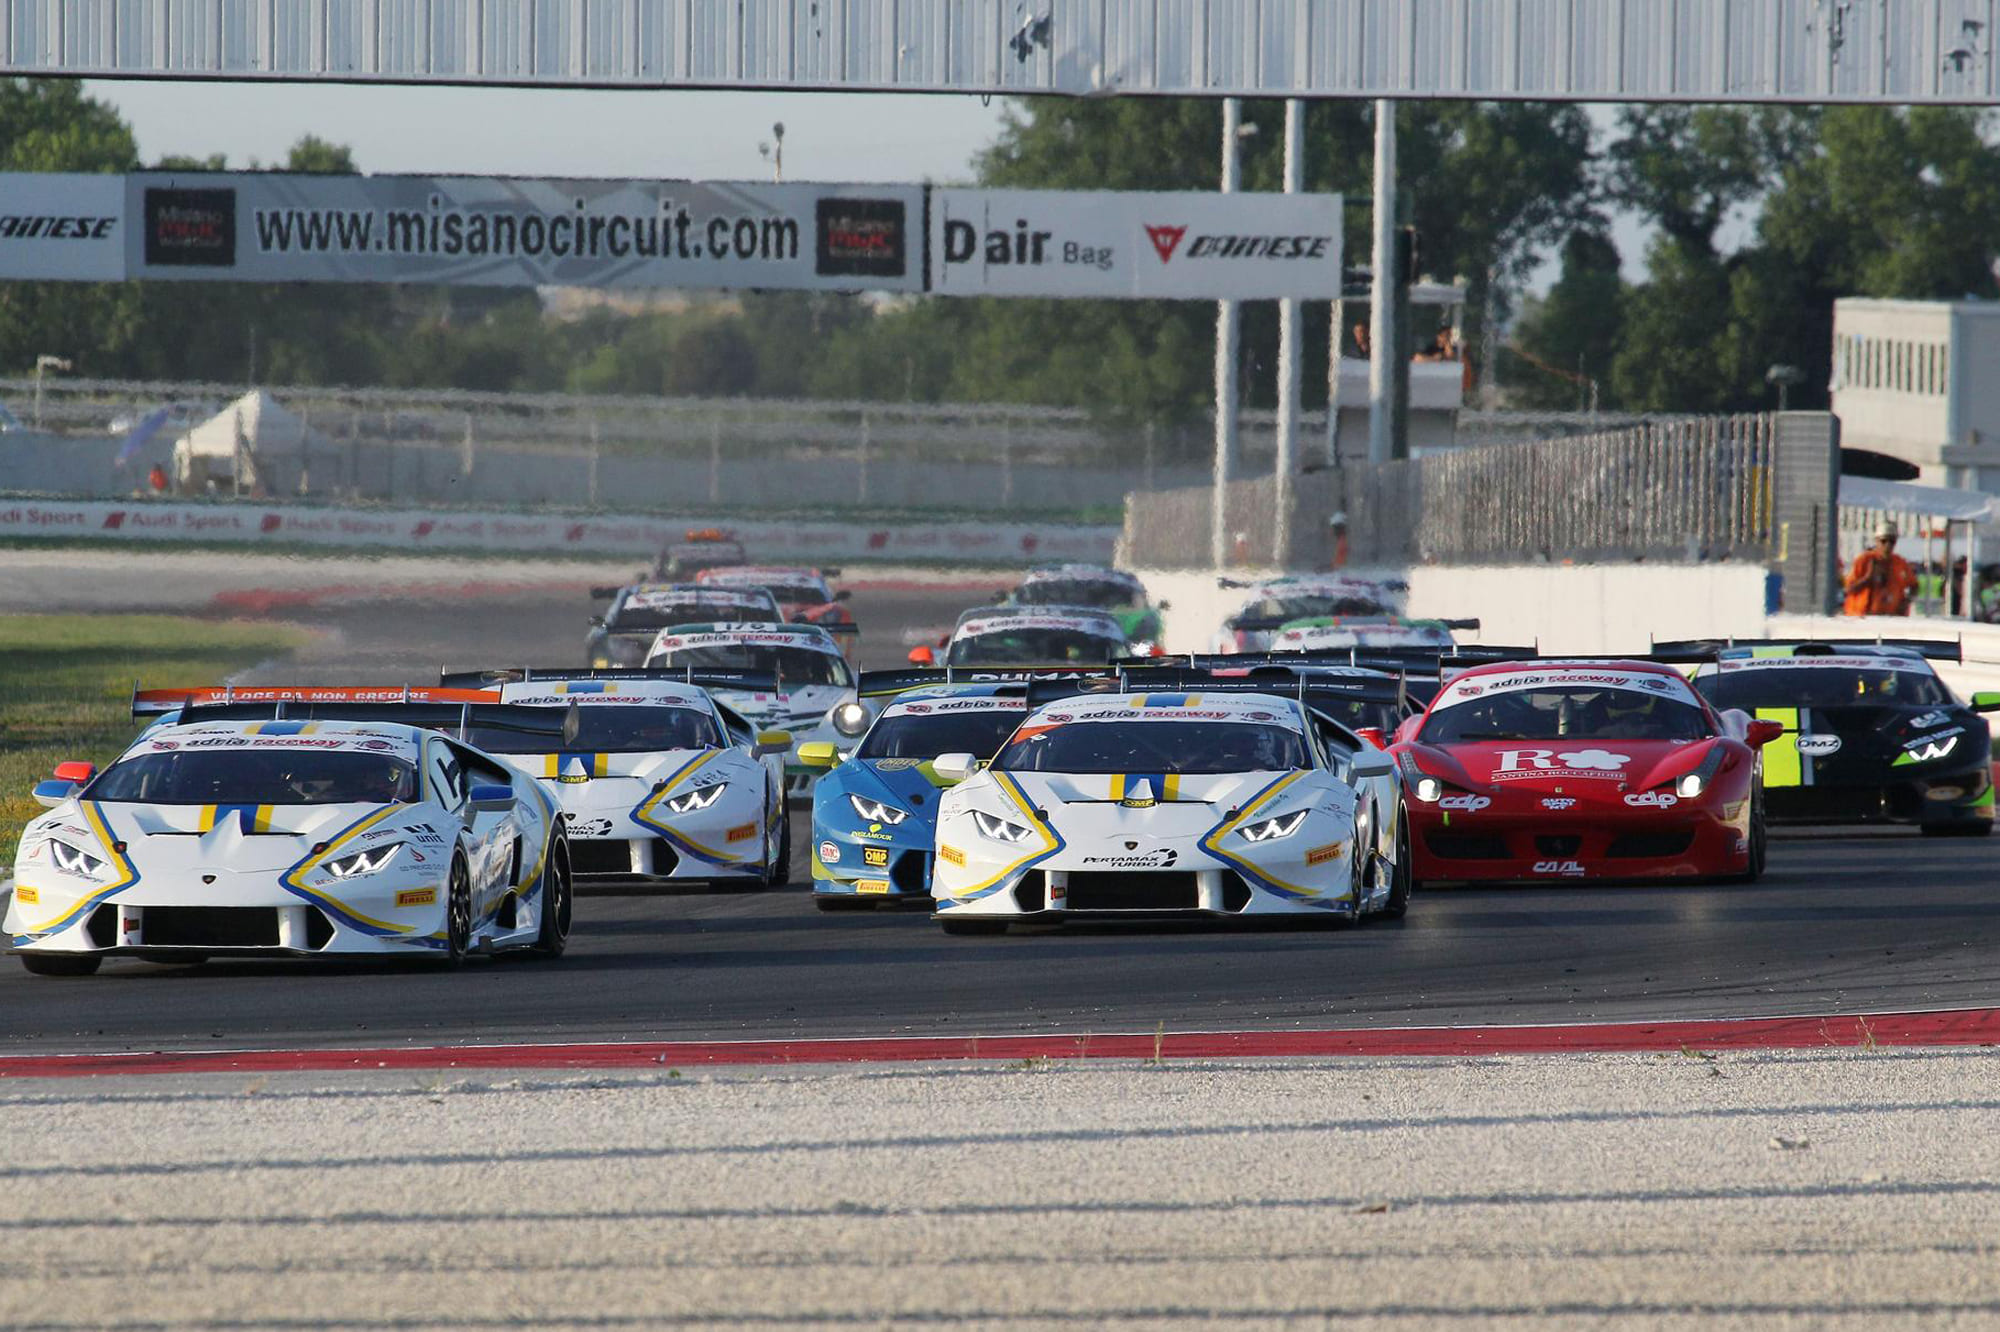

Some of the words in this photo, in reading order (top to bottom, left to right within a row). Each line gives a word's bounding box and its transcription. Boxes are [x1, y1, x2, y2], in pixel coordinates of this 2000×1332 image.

[256, 195, 799, 260] www.misanocircuit.com
[1062, 241, 1115, 271] Bag
[132, 512, 176, 528] Audi
[1745, 657, 1796, 667] adria
[1798, 657, 1871, 667] raceway
[1488, 675, 1546, 688] adria
[1547, 675, 1630, 685] raceway
[938, 701, 994, 710] adria
[1079, 710, 1140, 719] adria
[1142, 711, 1232, 720] raceway
[186, 738, 250, 748] adria
[252, 738, 346, 749] raceway
[1493, 749, 1561, 773] R
[1623, 791, 1678, 809] cdp
[415, 834, 445, 843] unit
[864, 852, 888, 863] OMP
[1308, 842, 1341, 865] PIRELLI
[1083, 857, 1160, 865] PERTAMAX
[399, 890, 434, 905] PIRELLI
